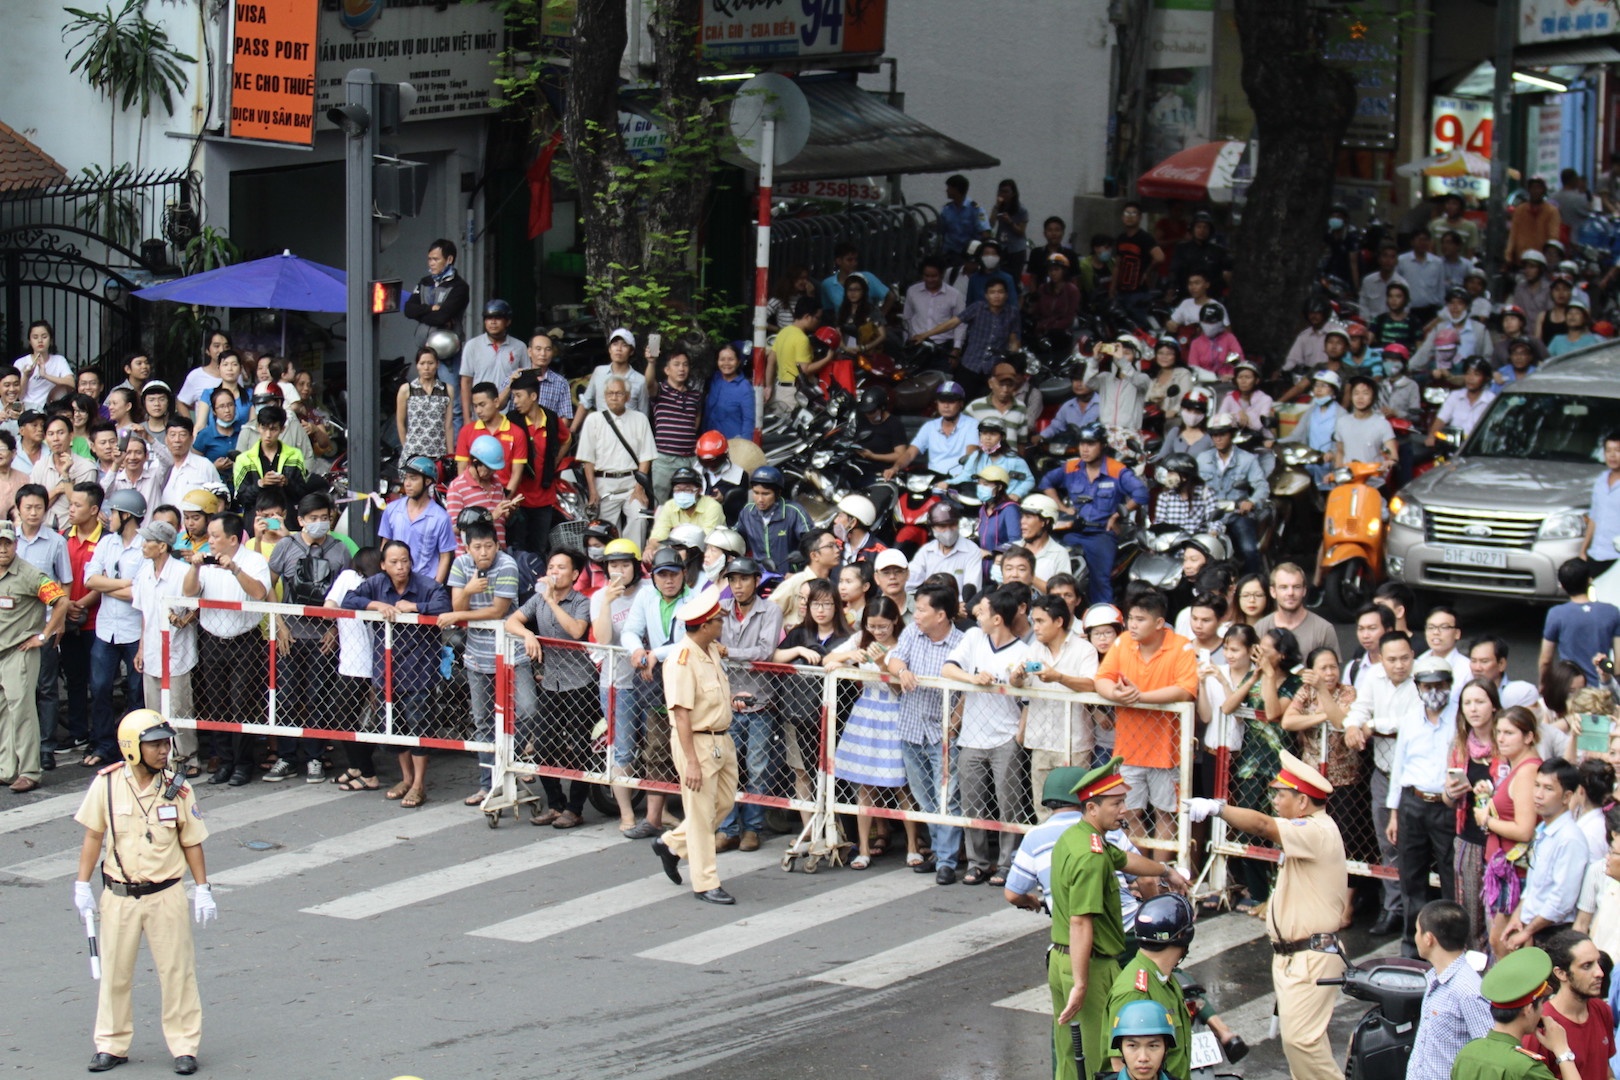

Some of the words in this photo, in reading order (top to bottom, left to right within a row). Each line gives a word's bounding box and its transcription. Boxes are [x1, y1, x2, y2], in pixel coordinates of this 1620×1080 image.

[237, 4, 267, 24] VISA
[801, 0, 842, 46] 94
[235, 37, 269, 57] PASS
[275, 41, 310, 61] PORT
[367, 37, 377, 58] LÝ
[377, 40, 399, 61] DỊCH
[402, 39, 414, 60] VỤ
[416, 38, 429, 55] DU
[430, 36, 450, 58] LỊCH
[452, 30, 473, 56] VIỆT
[474, 29, 497, 54] NHẬT
[234, 72, 252, 91] XE
[256, 74, 280, 93] CHO
[283, 74, 315, 96] THUÊ
[232, 106, 255, 127] DỊCH
[257, 109, 271, 130] VỤ
[272, 106, 293, 125] SÂN
[294, 113, 313, 129] BAY
[1434, 114, 1494, 160] 94
